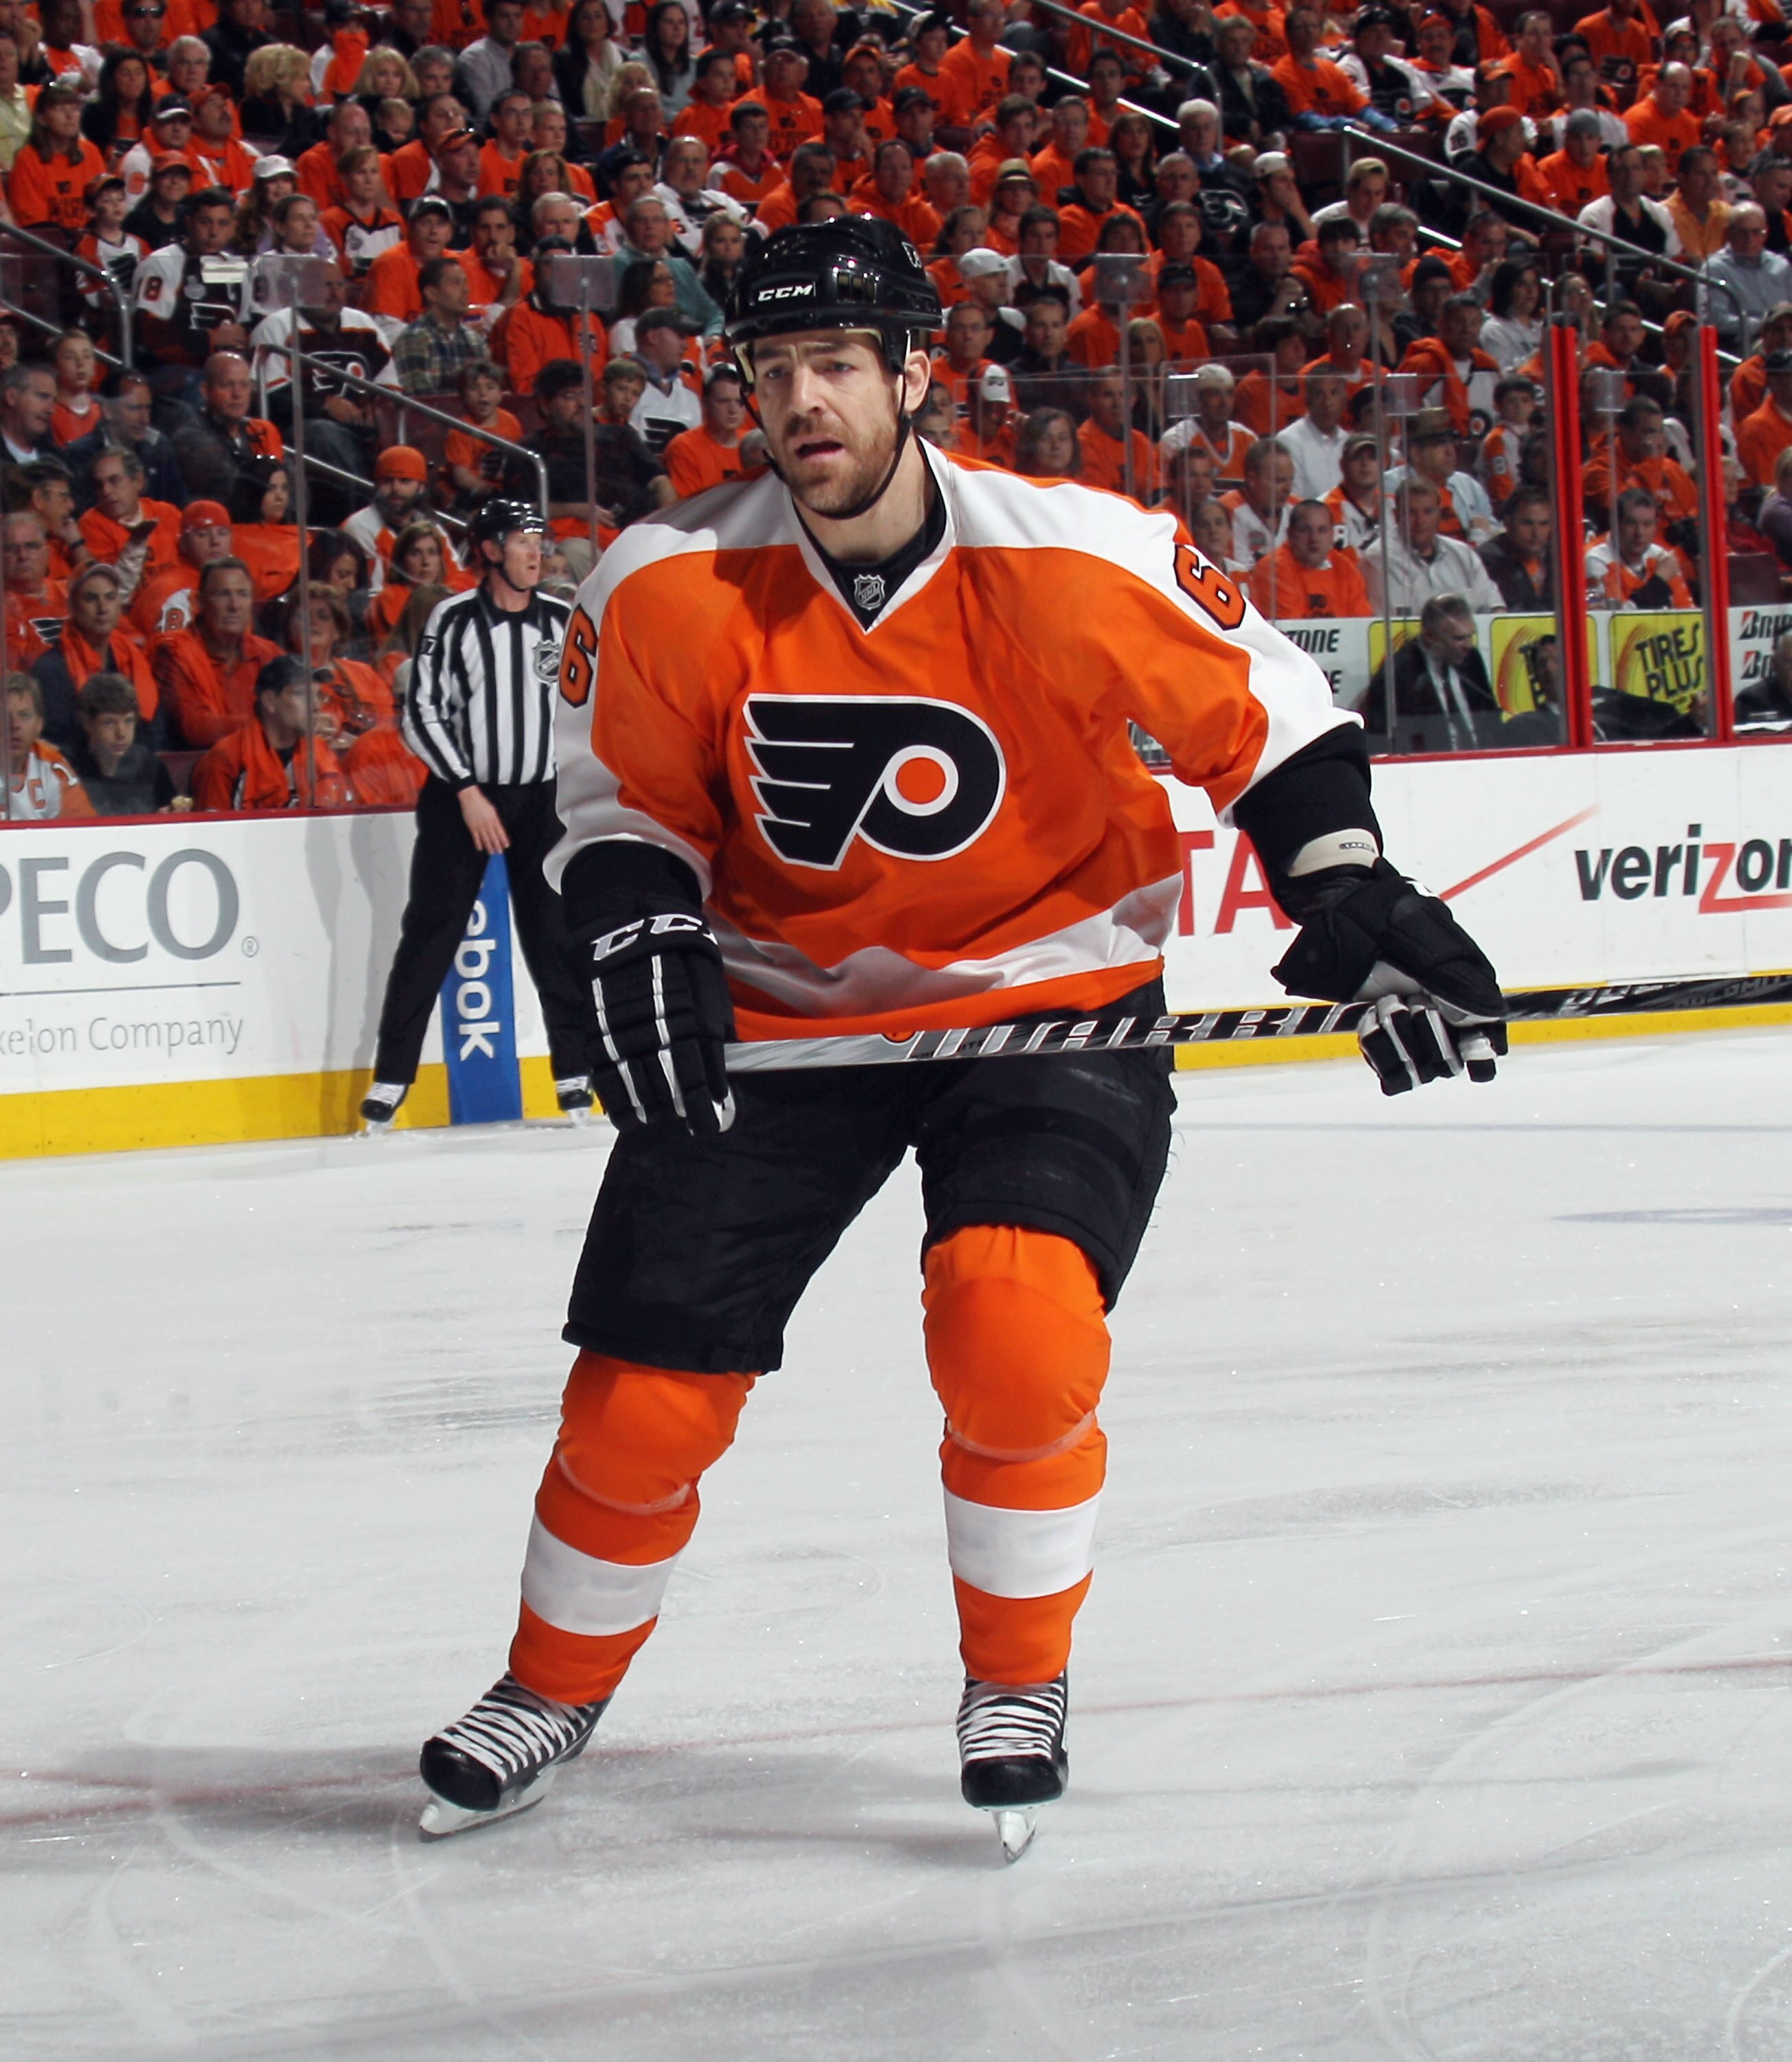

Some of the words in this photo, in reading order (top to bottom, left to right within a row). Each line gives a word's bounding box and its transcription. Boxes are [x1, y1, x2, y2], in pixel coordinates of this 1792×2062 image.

[757, 285, 813, 302] CCM
[1173, 544, 1246, 630] 6
[559, 603, 598, 709] 6
[1635, 623, 1701, 672] TIRES
[1646, 655, 1704, 700] PLUS
[0, 848, 239, 964] ECO
[454, 898, 501, 1062] ebok
[89, 1015, 243, 1058] Company
